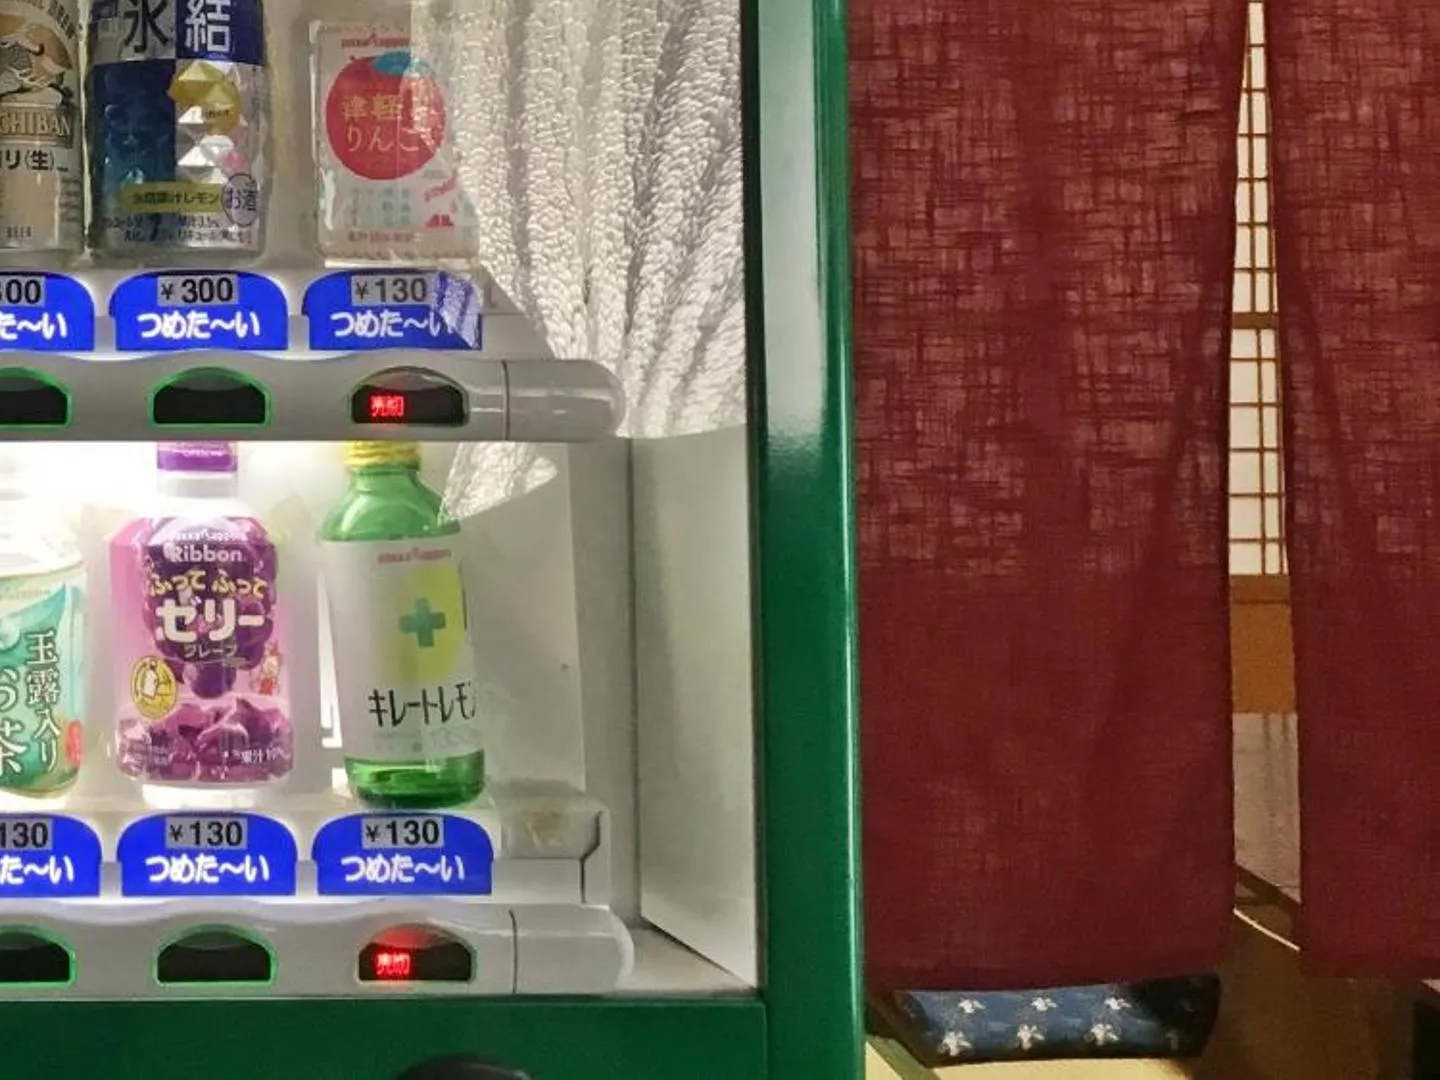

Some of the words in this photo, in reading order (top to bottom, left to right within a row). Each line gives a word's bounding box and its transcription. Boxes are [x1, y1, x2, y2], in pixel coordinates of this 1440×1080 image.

[161, 279, 234, 304] ¥300
[356, 280, 427, 304] ¥130
[163, 541, 243, 562] Ribbon
[155, 596, 265, 642] ゼリー
[25, 630, 61, 771] 玉露入り
[170, 822, 243, 846] ¥130
[365, 820, 439, 845] ¥130
